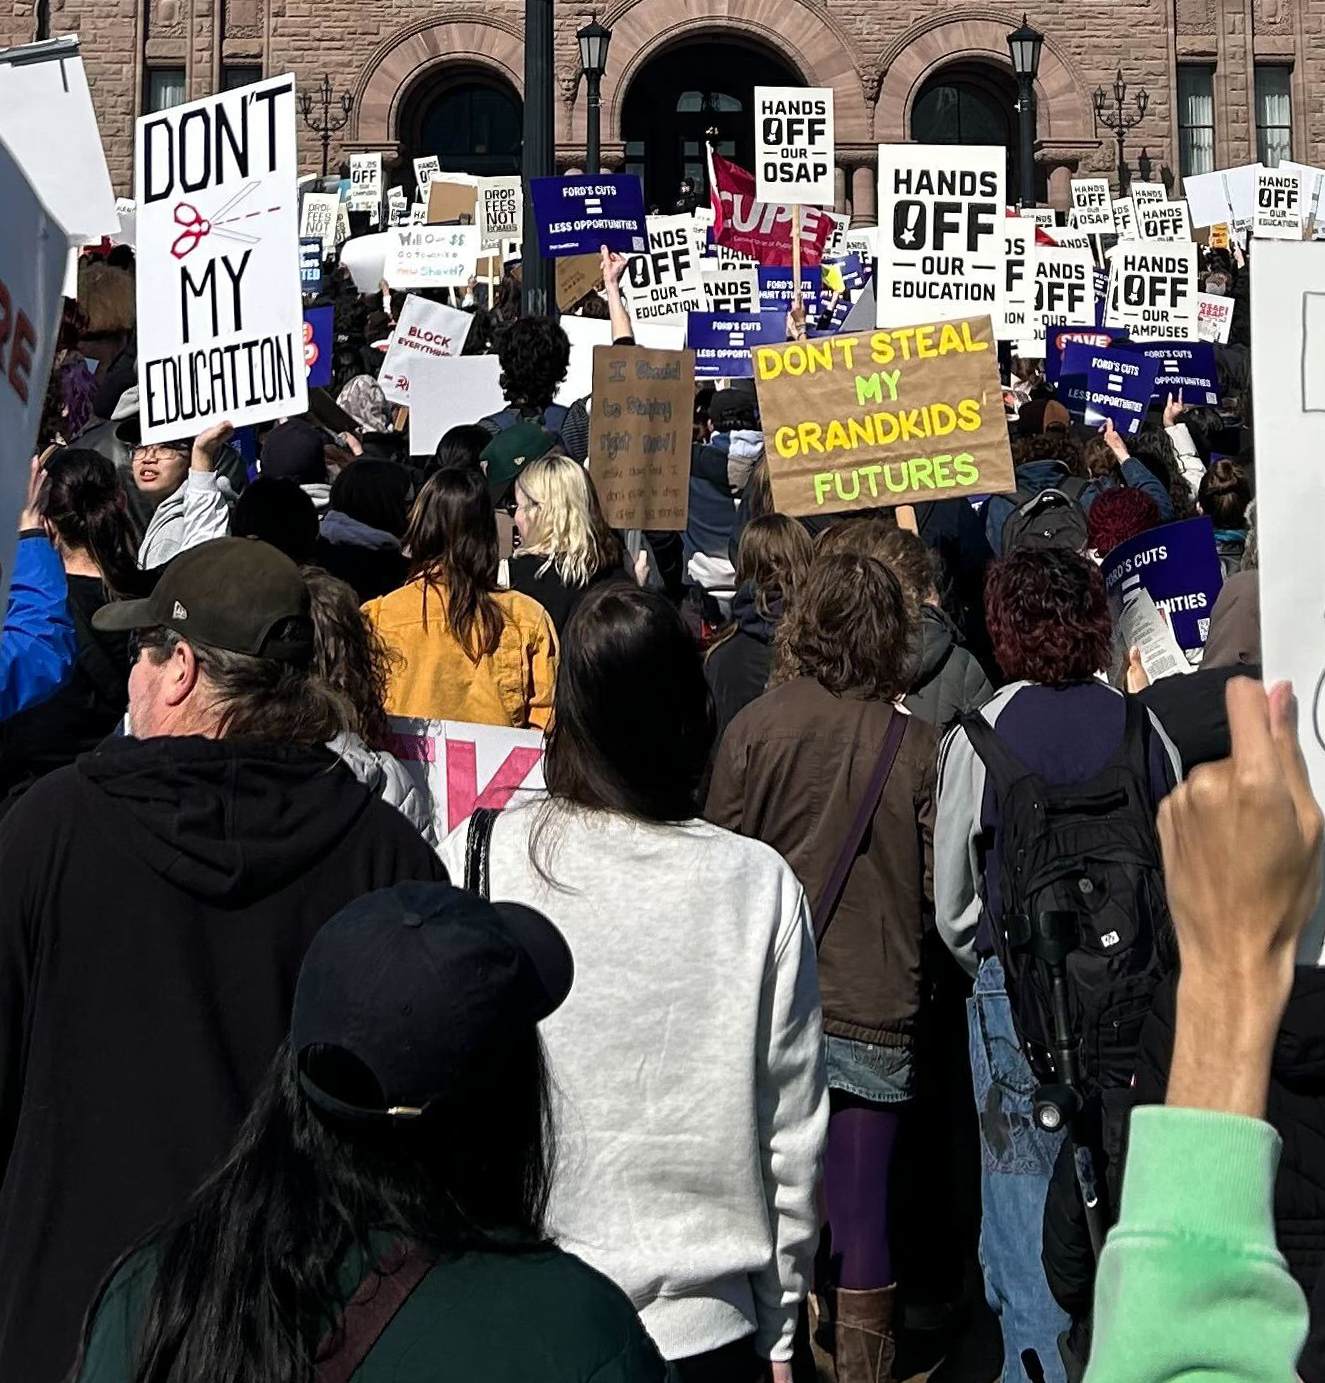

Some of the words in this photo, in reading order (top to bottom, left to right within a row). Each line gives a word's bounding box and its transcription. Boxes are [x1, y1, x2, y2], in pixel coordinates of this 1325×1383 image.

[762, 100, 826, 115] HANDS
[762, 117, 826, 145] OFF
[143, 82, 292, 204] DON'T
[781, 148, 808, 159] OUR
[352, 169, 377, 184] OFF
[764, 162, 827, 183] OSAP
[893, 169, 998, 198] HANDS
[1074, 184, 1106, 193] HANDS
[1258, 175, 1299, 189] HANDS
[484, 189, 515, 200] DROP
[562, 186, 593, 198] FORD'S
[594, 185, 617, 196] CUTS
[1076, 193, 1106, 207] OFF
[1135, 189, 1163, 199] HANDS
[1258, 188, 1299, 210] OFF
[485, 199, 516, 212] FEES
[1142, 207, 1183, 220] HANDS
[1269, 210, 1287, 218] OUR
[486, 211, 517, 225] NOT
[549, 222, 573, 234] LESS
[573, 219, 638, 232] OPPORTUNITIES
[893, 199, 998, 253] OFF
[1079, 213, 1110, 225] OSAP
[1258, 218, 1299, 228] EDUCATION
[306, 221, 329, 236] NOT
[1144, 218, 1183, 238] OFF
[650, 228, 688, 250] NDS
[1059, 237, 1089, 249] ANDS
[629, 247, 691, 289] OFF
[921, 256, 965, 276] OUR
[1036, 262, 1085, 280] ANDS
[1124, 255, 1189, 274] HANDS
[179, 248, 253, 344] MY
[650, 286, 678, 302] OUR
[704, 280, 751, 297] ANDS
[892, 281, 996, 302] EDUCATION
[1123, 274, 1189, 308] OFF
[636, 298, 700, 320] EDUCATION
[1142, 309, 1170, 323] OUR
[712, 321, 739, 332] FORD'S
[740, 320, 761, 331] CUTS
[1041, 314, 1067, 326] OUR
[408, 326, 452, 348] BLOCK
[696, 347, 715, 358] LESS
[757, 336, 860, 381] DON'T
[869, 321, 989, 365] STEAL
[1144, 349, 1172, 359] FORD'S
[1172, 350, 1193, 359] CUTS
[608, 360, 627, 383] I
[1091, 356, 1120, 373] FORD'S
[1121, 364, 1140, 376] CUTS
[145, 333, 296, 429] EDUCATION
[854, 368, 902, 406] MY
[1154, 375, 1212, 388] OPPORTUNITIES
[602, 397, 622, 418] be
[1068, 387, 1092, 400] LESS
[1091, 392, 1143, 413] OPPORTUNITIES
[774, 389, 988, 460] GRANDKIDS'
[812, 451, 980, 506] FUTURES
[1134, 545, 1168, 569] CUTS
